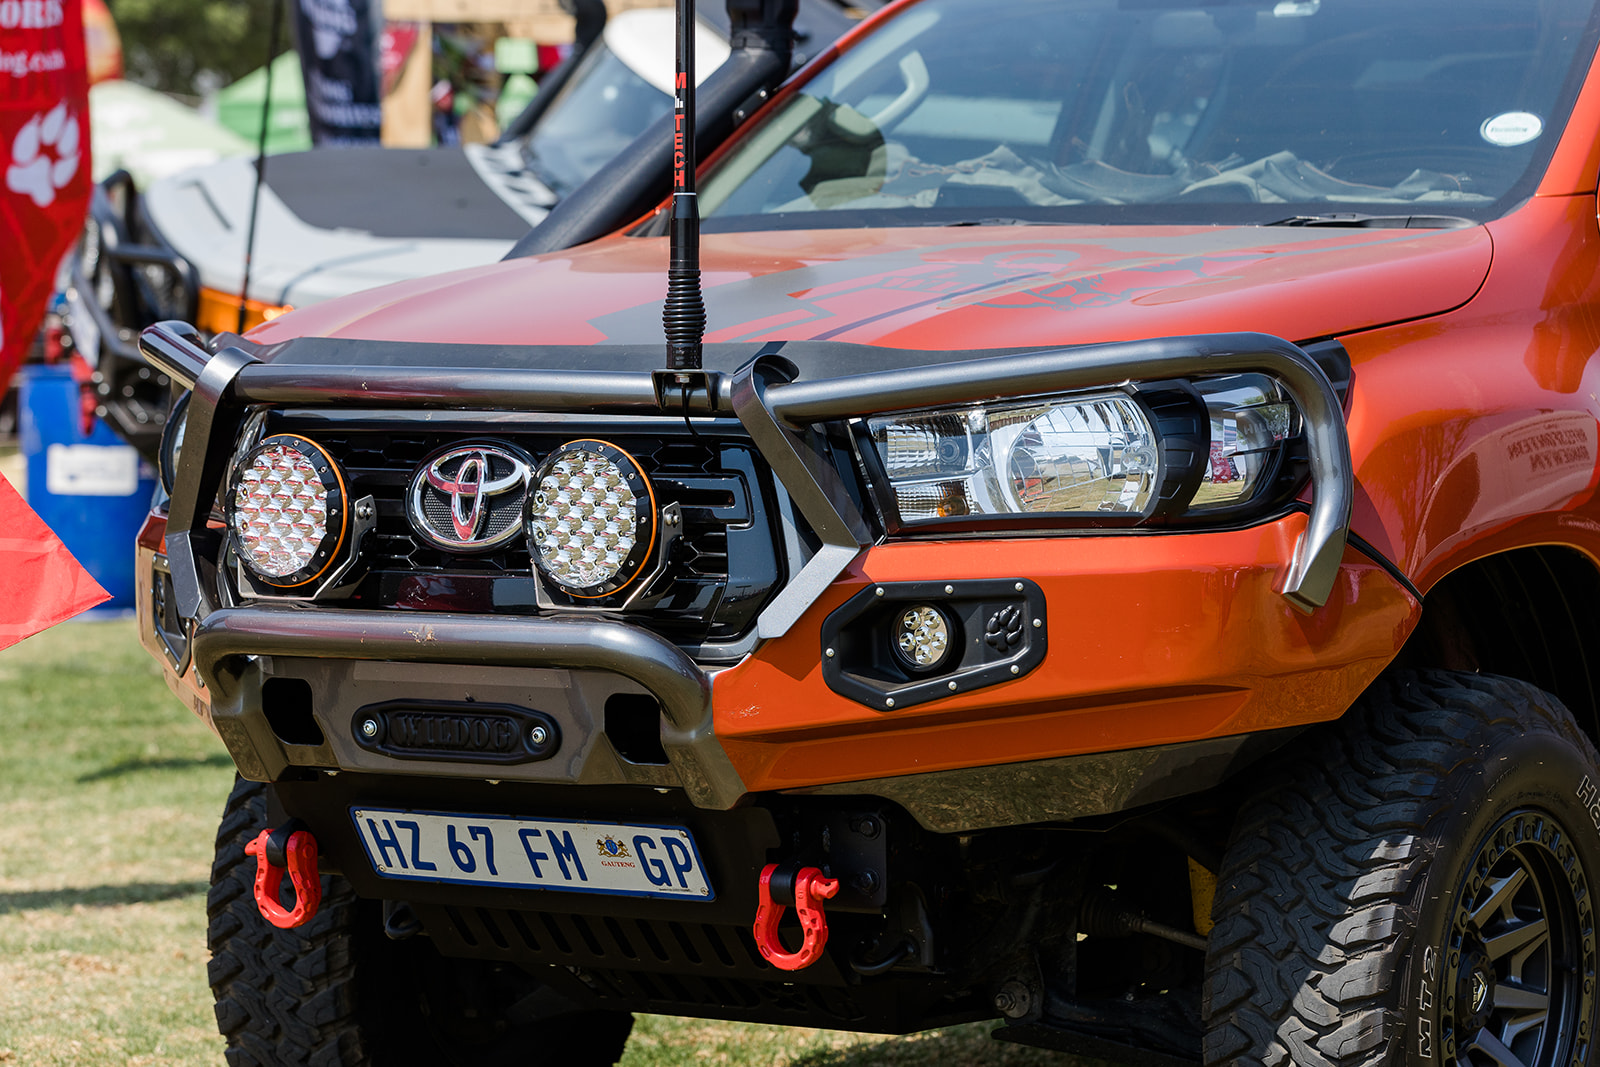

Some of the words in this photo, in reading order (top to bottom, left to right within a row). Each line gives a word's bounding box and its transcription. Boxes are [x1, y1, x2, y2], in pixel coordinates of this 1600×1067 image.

[392, 714, 519, 751] WILDOG
[366, 818, 437, 872] HZ
[447, 824, 499, 876] 67
[518, 828, 588, 882] FM
[632, 835, 693, 889] GP
[600, 860, 636, 869] GAUTENG
